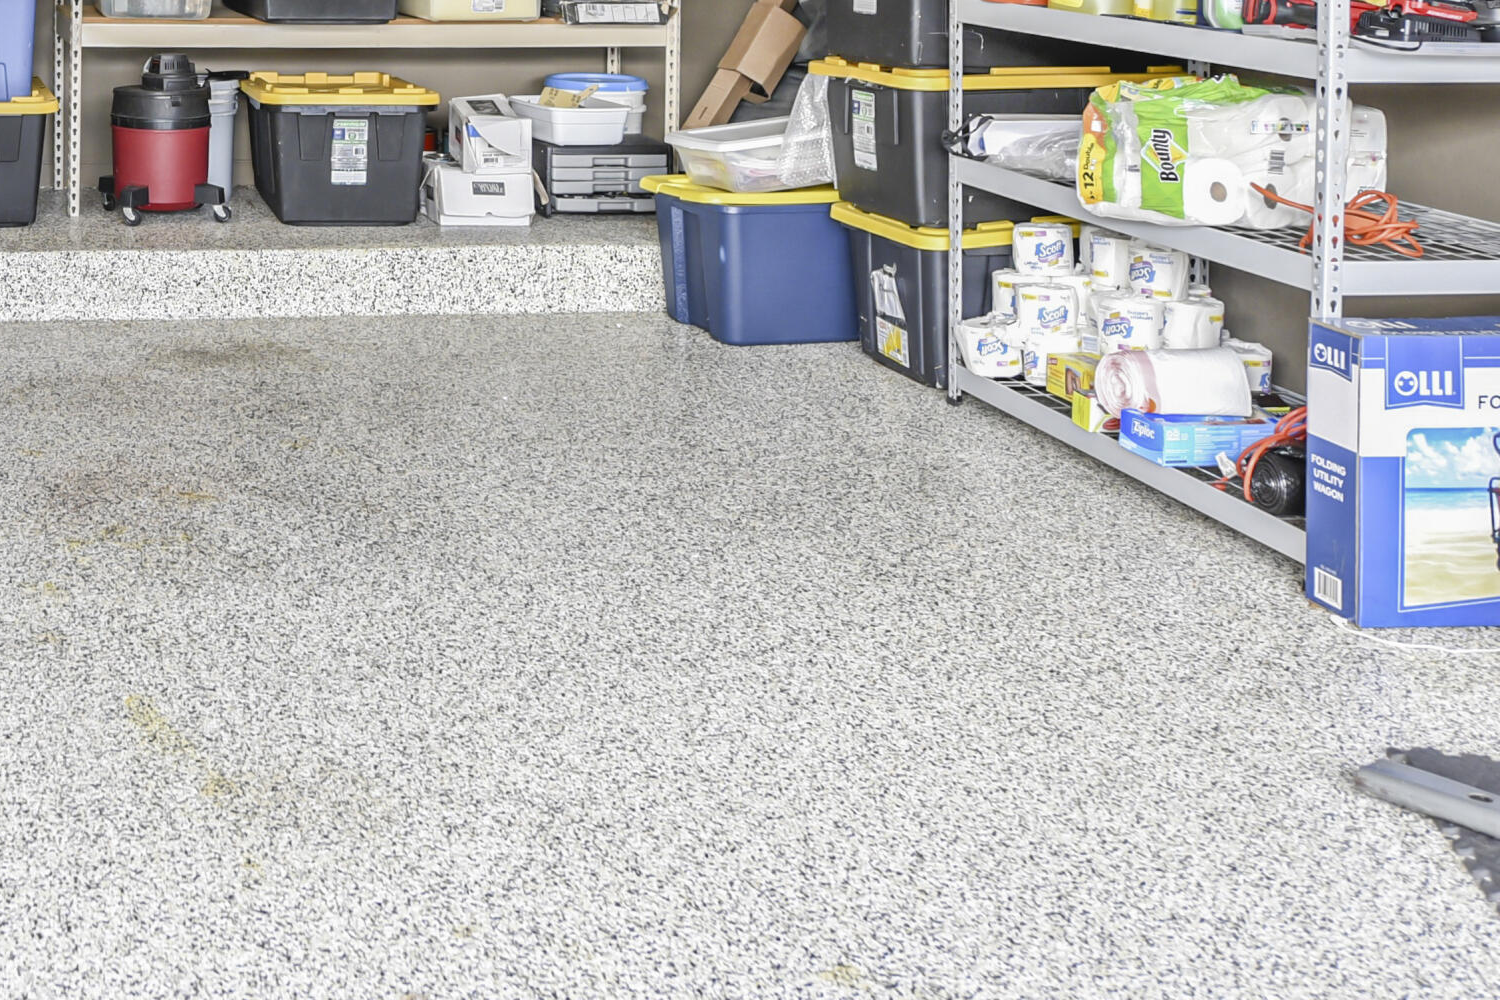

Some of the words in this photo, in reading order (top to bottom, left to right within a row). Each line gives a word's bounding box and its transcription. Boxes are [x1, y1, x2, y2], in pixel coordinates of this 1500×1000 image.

[1151, 129, 1179, 182] Bounty
[1039, 240, 1063, 257] Scott
[1131, 268, 1152, 282] Scott
[1041, 305, 1066, 321] Scott
[1103, 323, 1128, 337] Scott
[980, 341, 1007, 356] Scott
[1313, 342, 1346, 370] OLLI
[1394, 370, 1456, 396] OLLI
[1132, 420, 1156, 440] Ziploc
[1311, 453, 1347, 477] FOLDING
[1312, 467, 1345, 489] UTILITY
[1312, 480, 1345, 503] WAGON
